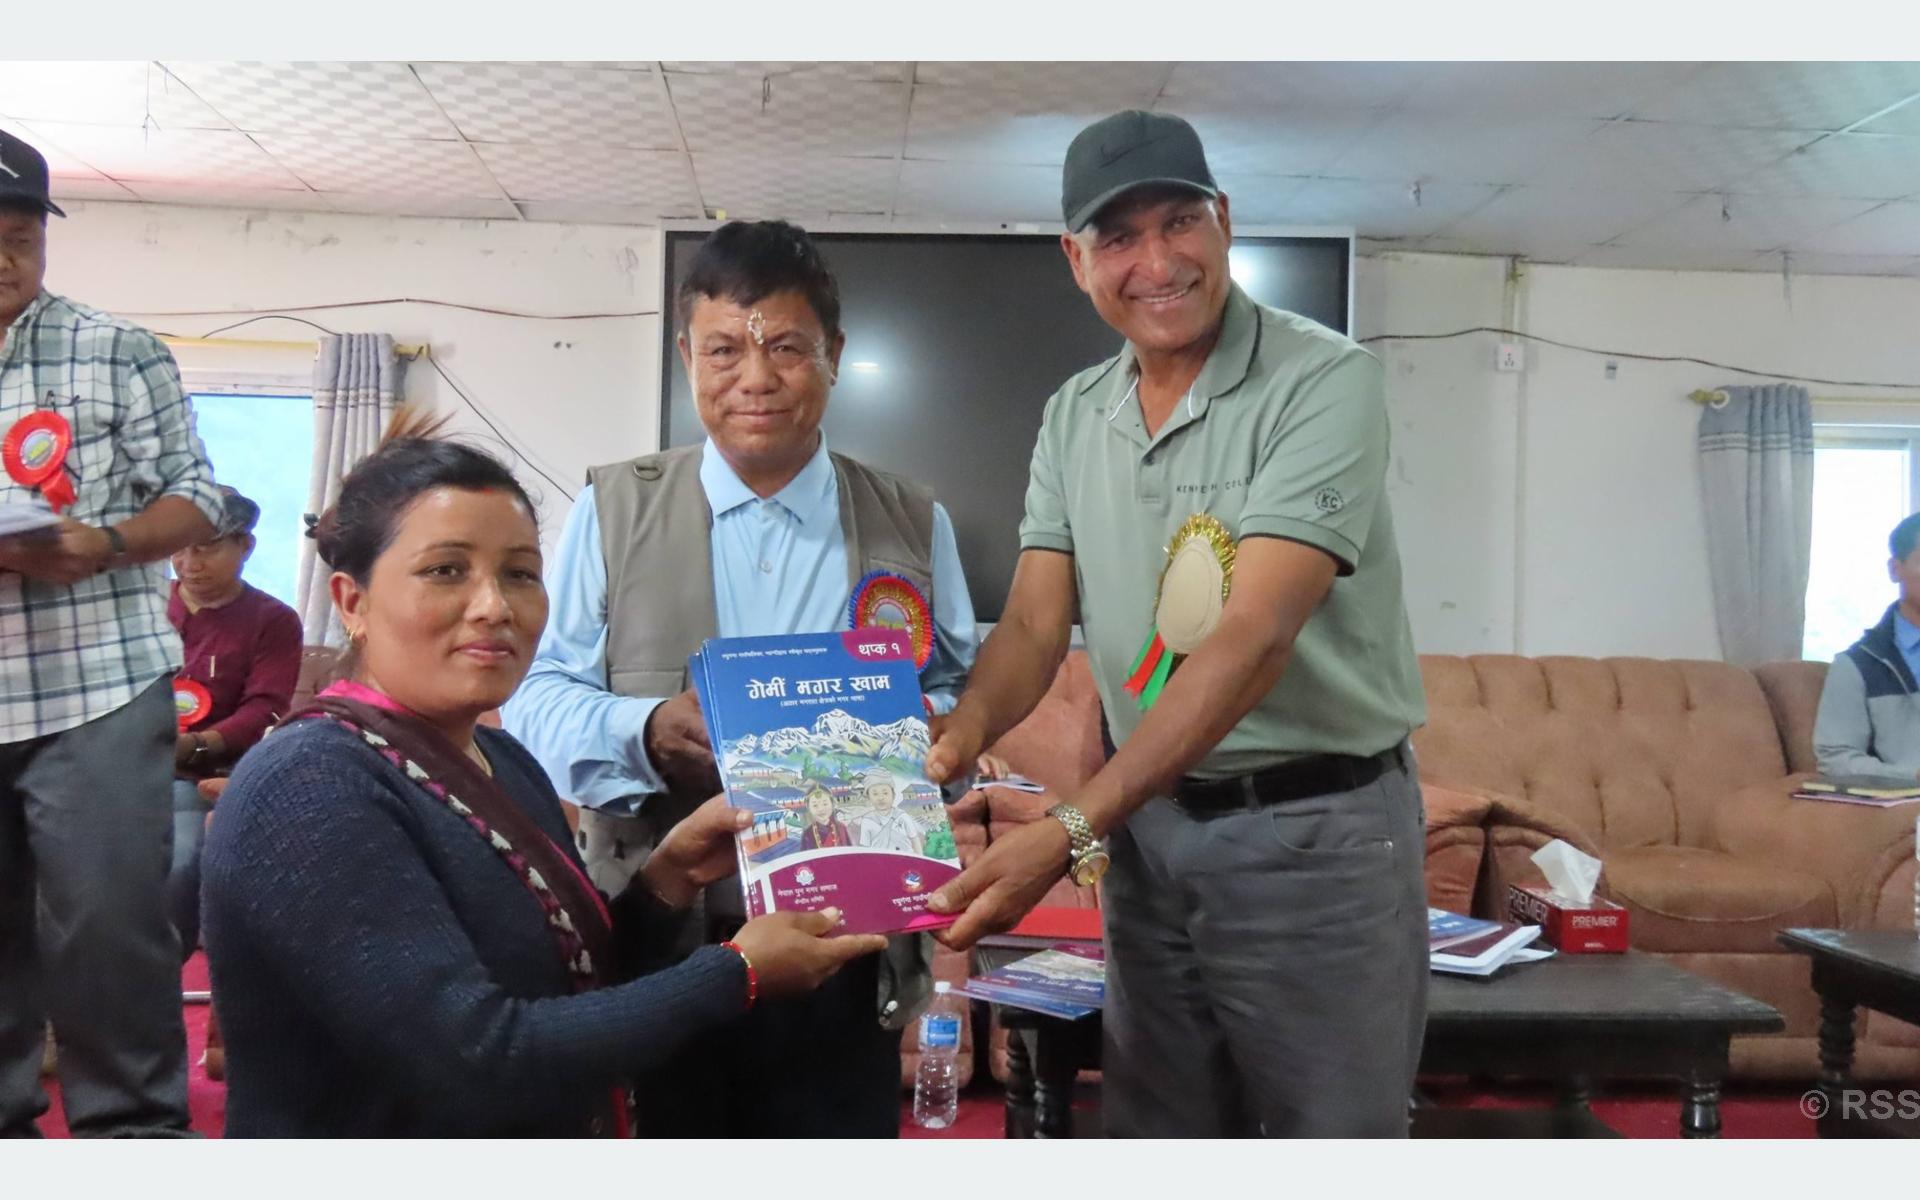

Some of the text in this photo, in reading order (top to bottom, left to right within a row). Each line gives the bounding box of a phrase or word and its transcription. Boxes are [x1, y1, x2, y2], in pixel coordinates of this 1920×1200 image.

[1320, 493, 1338, 508] KC
[891, 642, 902, 655] १
[796, 678, 843, 695] मगर
[848, 675, 891, 692] खाम
[1572, 915, 1617, 927] PREMIER
